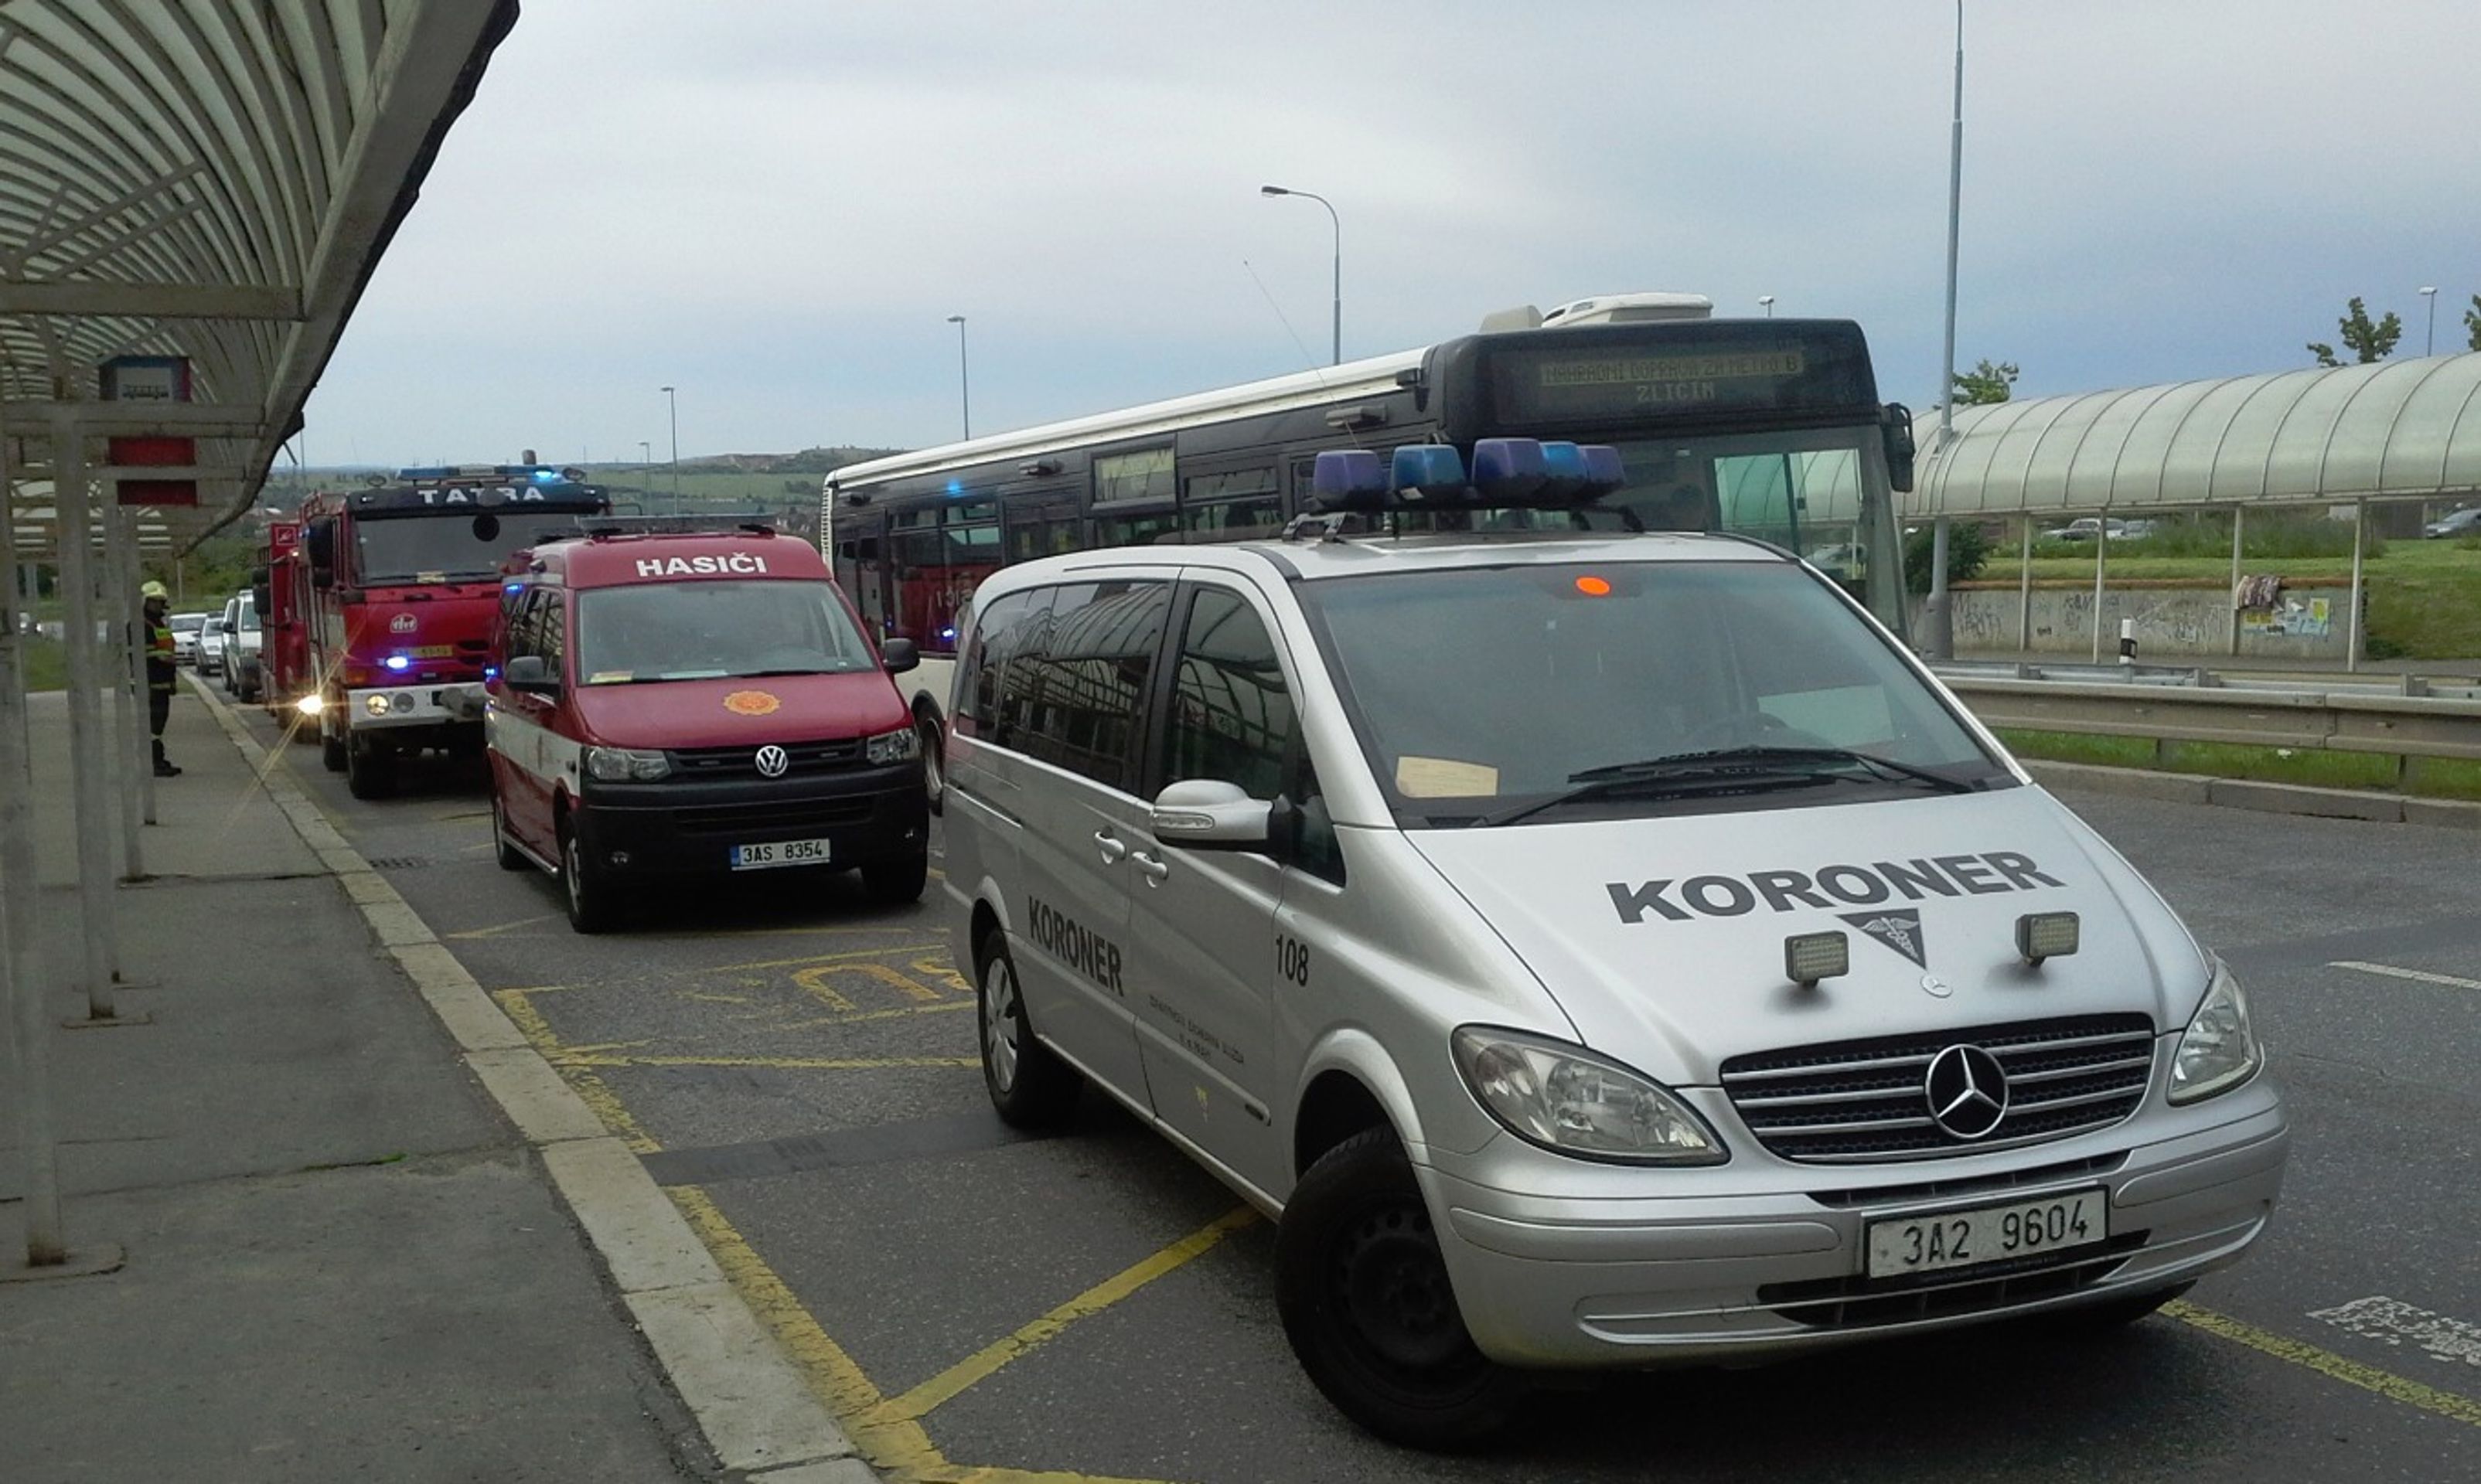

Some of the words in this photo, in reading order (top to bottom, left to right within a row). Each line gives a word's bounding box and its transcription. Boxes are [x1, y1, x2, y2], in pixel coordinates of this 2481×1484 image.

[636, 552, 768, 577] HASIČI
[743, 846, 773, 863] 3AS
[785, 841, 823, 859] 8354
[1606, 851, 2068, 924] KORONER
[1028, 895, 1124, 996] KORONER
[1276, 934, 1309, 987] 108
[1903, 1219, 1970, 1265] 3A2
[2002, 1200, 2087, 1251] 9604
